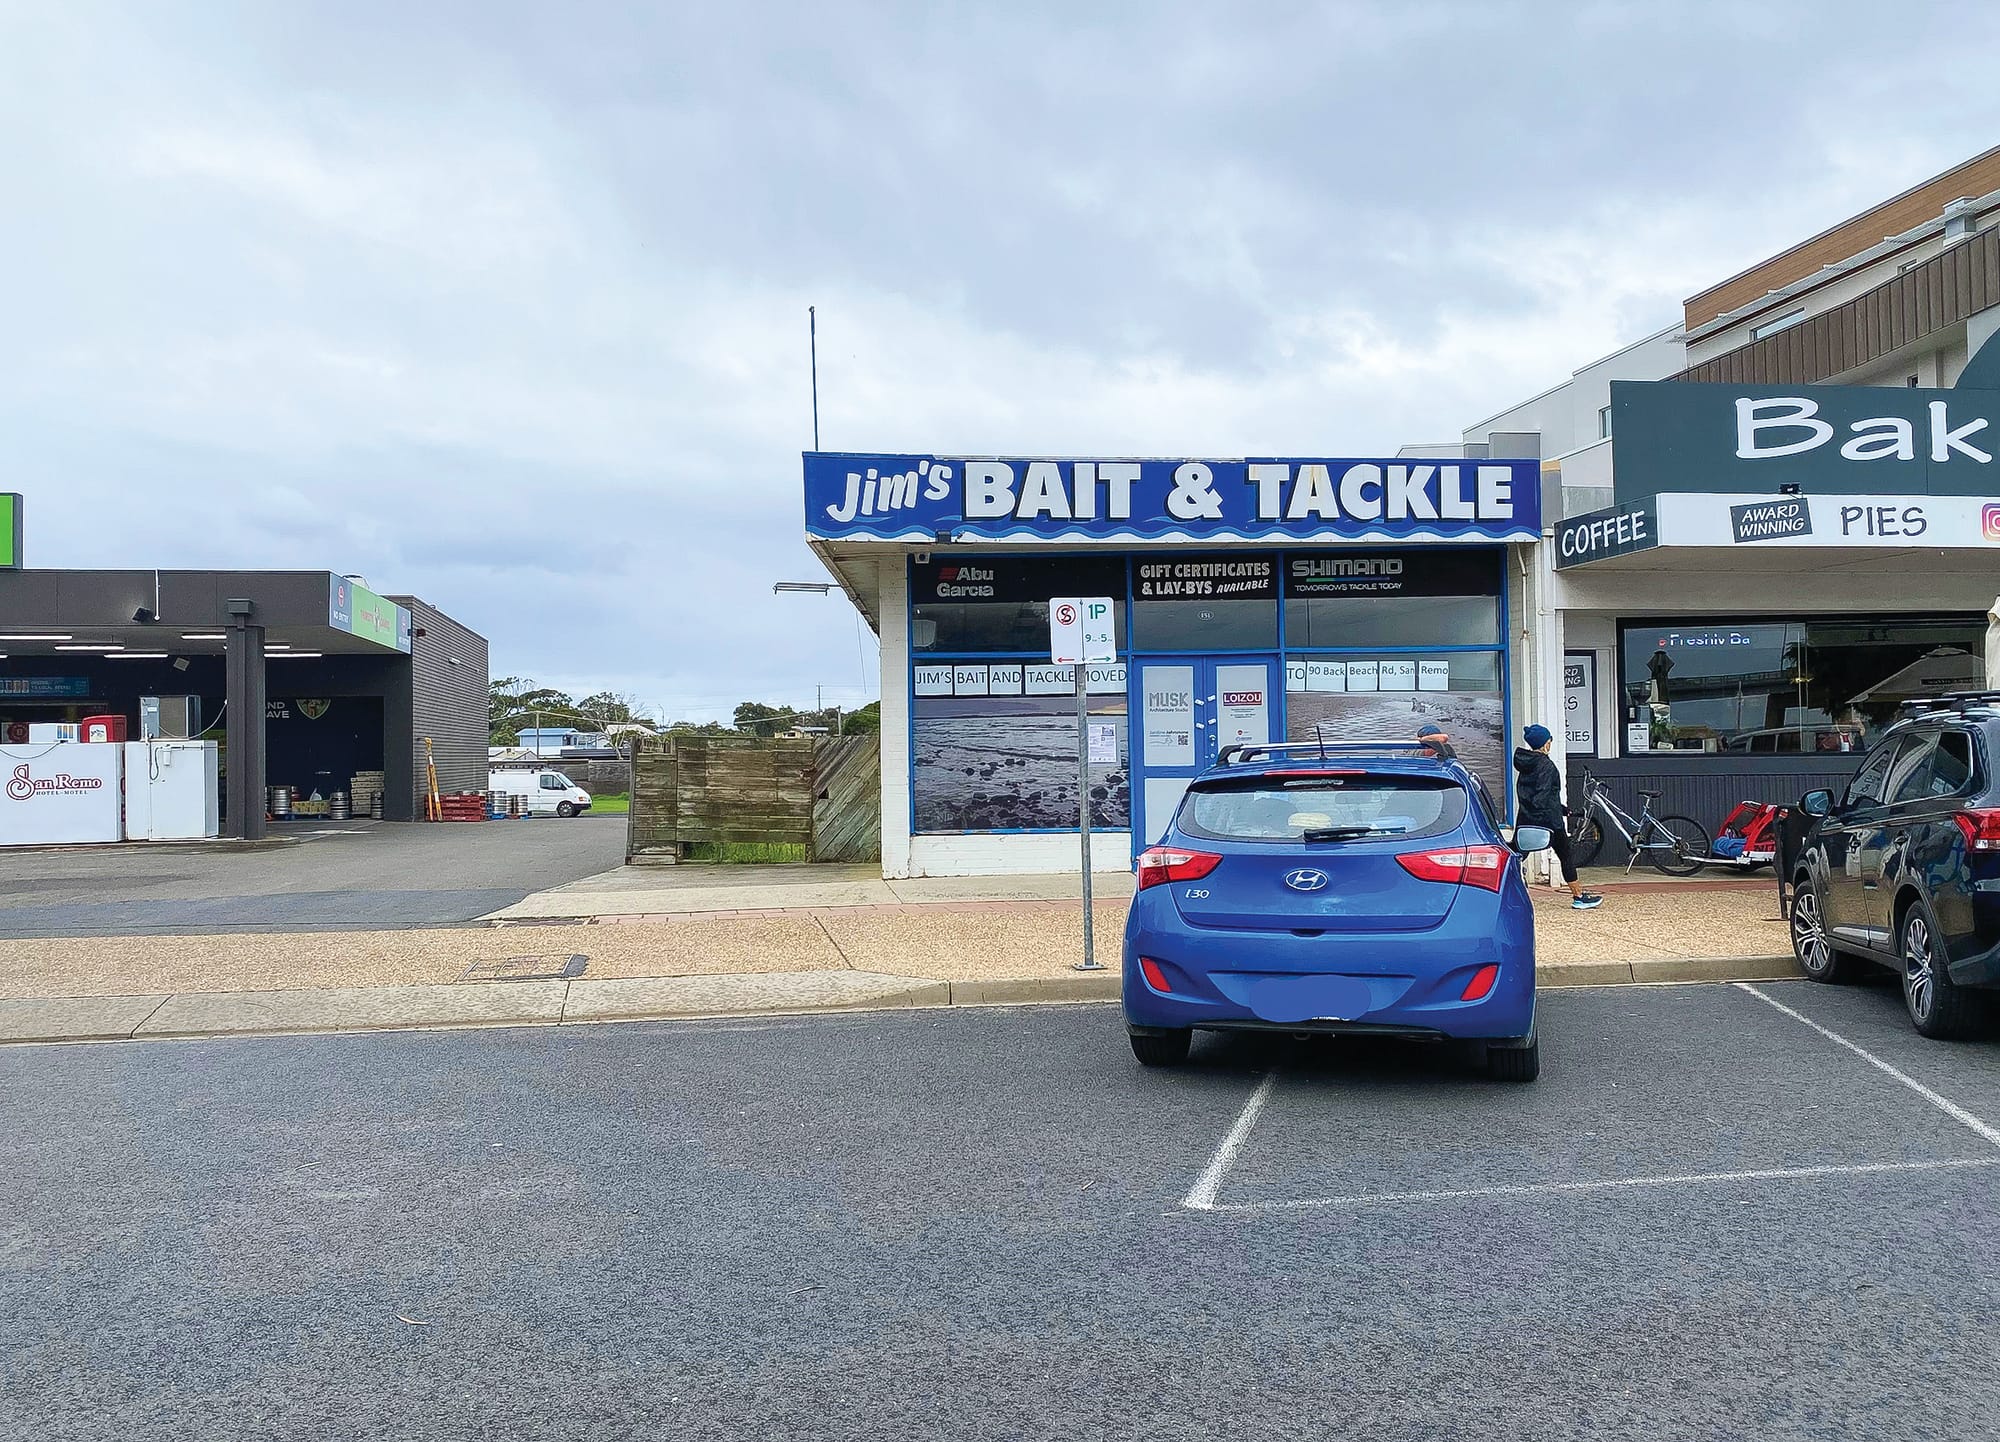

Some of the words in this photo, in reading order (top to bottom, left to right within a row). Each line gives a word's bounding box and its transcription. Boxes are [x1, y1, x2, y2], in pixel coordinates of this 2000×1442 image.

[1735, 397, 1993, 464] Bak
[826, 460, 952, 523] Jim's
[964, 462, 1141, 519] BAIT
[1166, 463, 1224, 520] &
[1248, 464, 1514, 521] TACKLE
[1742, 504, 1800, 523] AWARD
[1840, 506, 1928, 537] PIES
[1562, 510, 1647, 558] COFFEE
[1739, 518, 1805, 538] WINNING
[956, 567, 994, 581] Abu
[1140, 564, 1172, 578] GIFT
[1174, 562, 1270, 578] CERTIFICATES
[1292, 559, 1403, 577] SHIMANO
[936, 582, 994, 598] Garcia
[1141, 581, 1153, 595] &
[1156, 580, 1213, 595] LAY-BYS
[1216, 578, 1270, 594] AVAILABLE
[1348, 583, 1377, 591] TACKLE
[1088, 604, 1107, 620] 1P
[917, 671, 952, 684] JIM'S
[957, 671, 987, 684] BAIT
[991, 670, 1021, 684] AND
[1026, 670, 1074, 683] TACKLE
[1287, 667, 1305, 680] TO
[1308, 666, 1321, 675] 90
[1323, 667, 1345, 676] Back
[1349, 666, 1377, 675] Beach
[1382, 665, 1397, 677] Rd,
[1399, 666, 1415, 676] San
[1421, 665, 1449, 675] Remo
[1149, 692, 1188, 707] MUSK
[1223, 693, 1262, 703] LOIZOU
[6, 763, 54, 801] San
[55, 774, 103, 790] Remo
